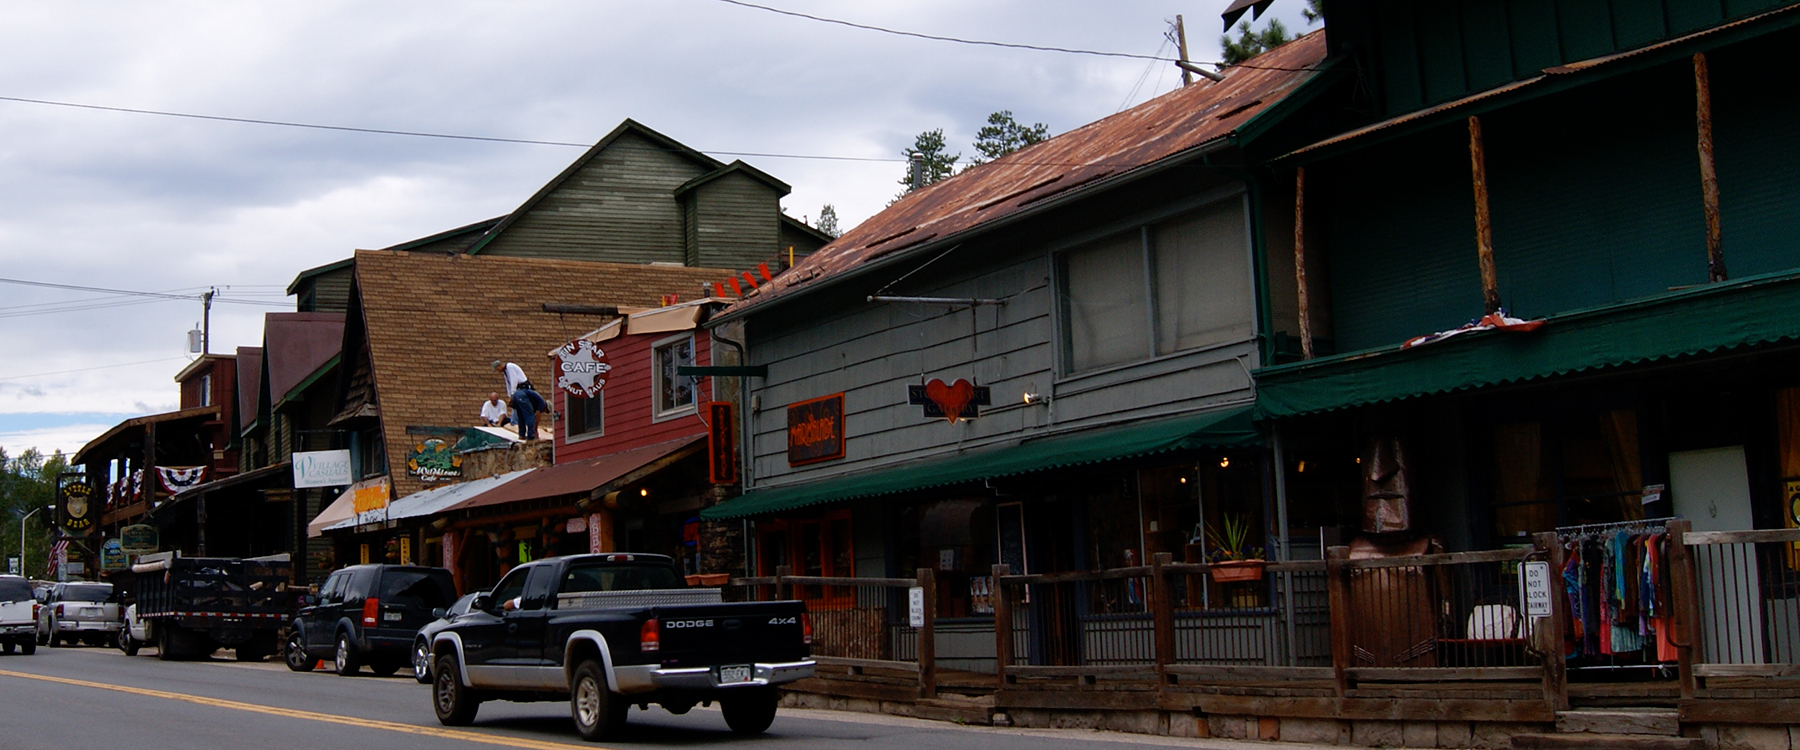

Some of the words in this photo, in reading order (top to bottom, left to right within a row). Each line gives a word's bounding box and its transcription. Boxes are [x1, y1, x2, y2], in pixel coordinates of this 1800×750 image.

[578, 340, 605, 358] STAR
[561, 362, 607, 373] CAFE
[313, 460, 349, 469] VILLAGE
[308, 467, 349, 478] CASUALS
[63, 484, 92, 497] LITTLE
[66, 518, 91, 529] BEAR
[1529, 570, 1539, 578] DO
[1528, 580, 1542, 588] NOT
[1528, 591, 1547, 599] LOCK
[666, 619, 715, 629] DODGE
